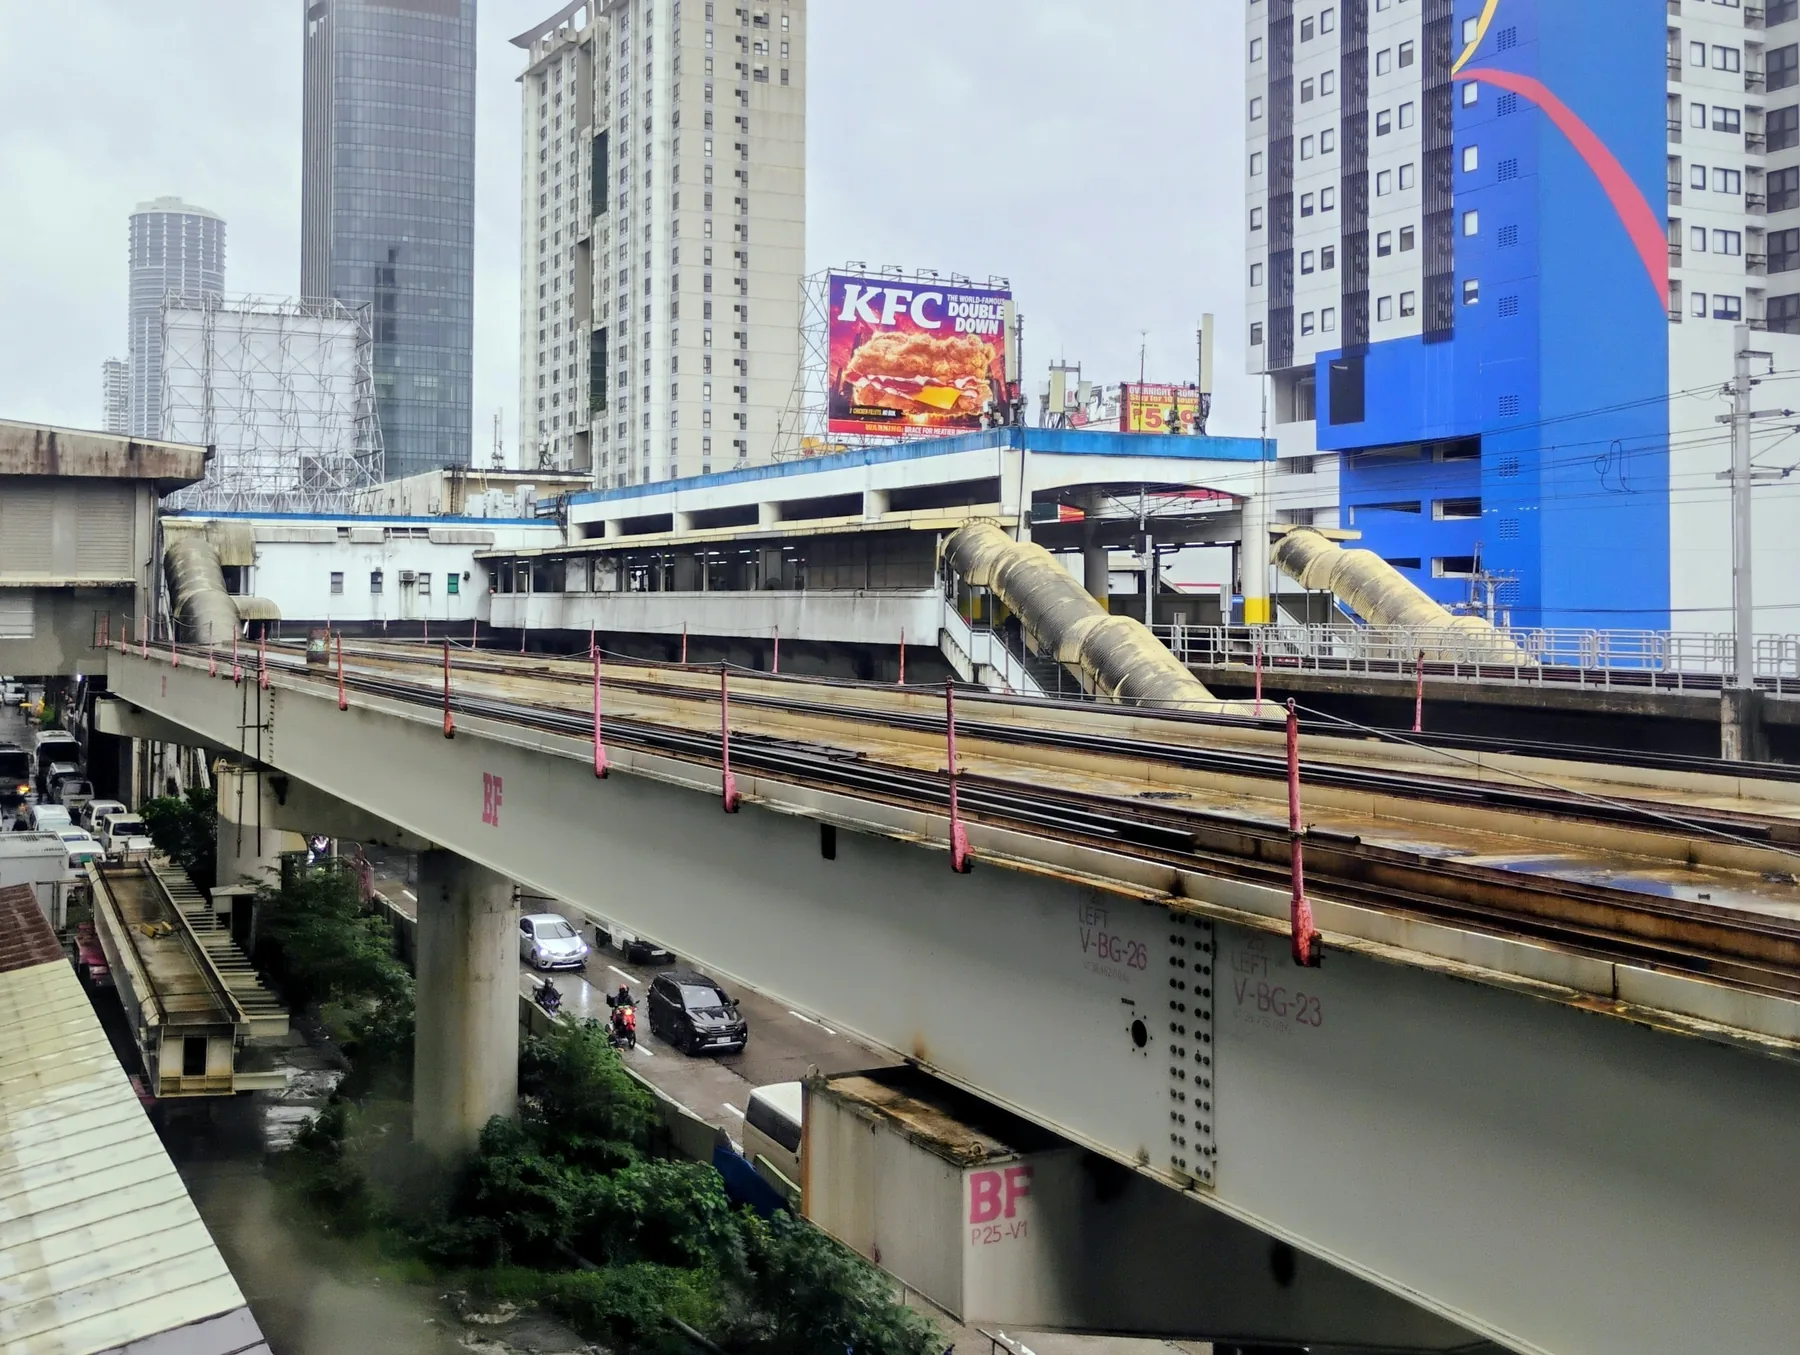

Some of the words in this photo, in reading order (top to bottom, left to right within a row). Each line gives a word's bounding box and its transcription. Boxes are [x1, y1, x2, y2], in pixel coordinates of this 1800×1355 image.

[837, 283, 943, 329] KFC
[946, 294, 958, 302] THE
[948, 302, 1004, 320] DOUBLE
[955, 317, 999, 335] DOWN
[482, 772, 503, 828] BF
[1079, 900, 1109, 929] LEFT
[1080, 927, 1147, 971] V-BG-26
[1233, 976, 1323, 1028] V-BG-23
[969, 1164, 1035, 1225] BF
